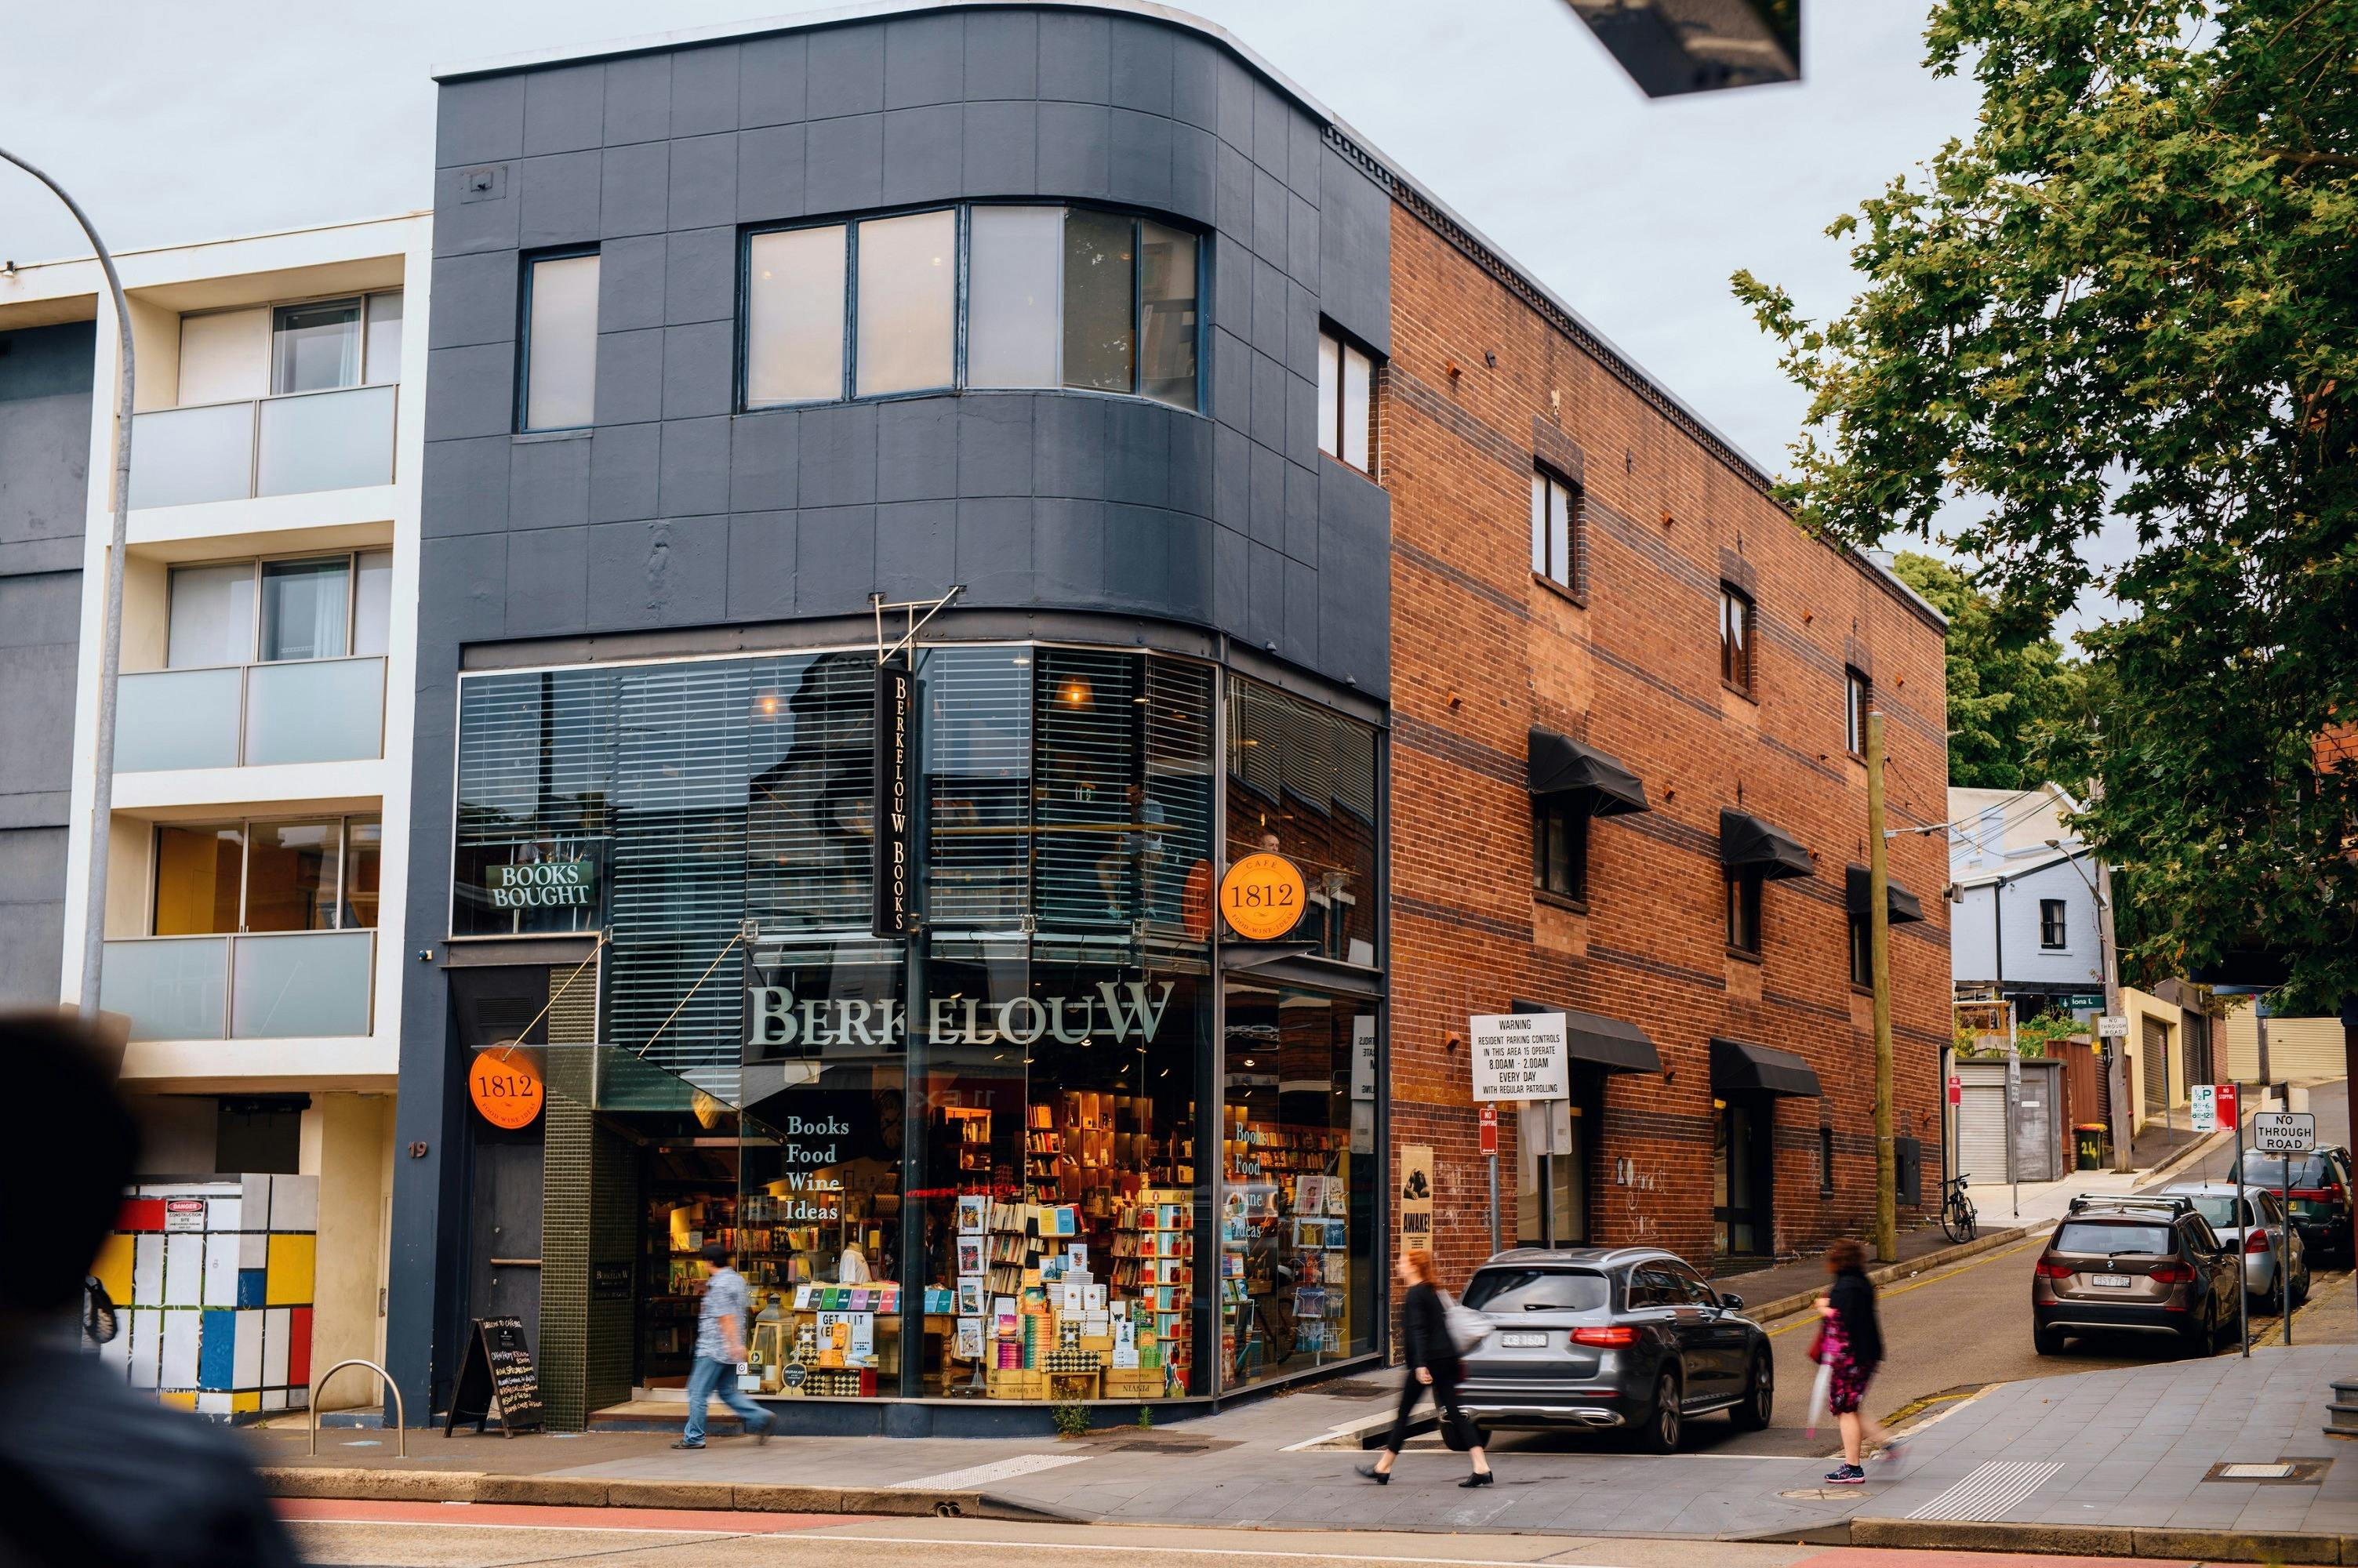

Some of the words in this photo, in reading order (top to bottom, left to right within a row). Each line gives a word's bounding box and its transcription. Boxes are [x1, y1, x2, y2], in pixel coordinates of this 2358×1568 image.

[891, 677, 907, 833] BERKELOUW
[1246, 860, 1277, 869] CAFÉ
[502, 865, 579, 887] BOOKS
[893, 841, 905, 930] BOOKS
[492, 885, 589, 907] BOUGHT
[1231, 884, 1293, 907] 1812
[1499, 1019, 1531, 1030] WARNING
[1478, 1036, 1504, 1045] RESIDENT
[1506, 1036, 1530, 1044] PARKING
[1531, 1034, 1560, 1044] CONTROLS
[1492, 1047, 1505, 1056] THIS
[1507, 1047, 1521, 1056] AREA
[1531, 1046, 1556, 1055] OPERATE
[1489, 1058, 1514, 1069] 8.00AM
[1524, 1058, 1549, 1069] 2.00AM
[1499, 1072, 1520, 1083] EVERY
[1524, 1071, 1536, 1082] DAY
[478, 1075, 533, 1098] 1812
[1483, 1085, 1497, 1094] WITH
[1499, 1085, 1524, 1094] REGULAR
[1526, 1083, 1557, 1093] PATROLLING
[787, 1116, 849, 1135] Books
[2276, 1116, 2292, 1124] NO
[1235, 1121, 1267, 1146] Books
[2258, 1127, 2311, 1137] THROUGH
[409, 1142, 427, 1159] 19
[2081, 1142, 2097, 1159] 24
[2267, 1139, 2302, 1149] ROAD
[787, 1144, 837, 1163] Food
[1235, 1153, 1261, 1176] Food
[787, 1172, 840, 1192] Wine
[785, 1200, 838, 1220] Ideas
[1404, 1213, 1430, 1233] AWAKE!
[823, 1315, 839, 1324] GET
